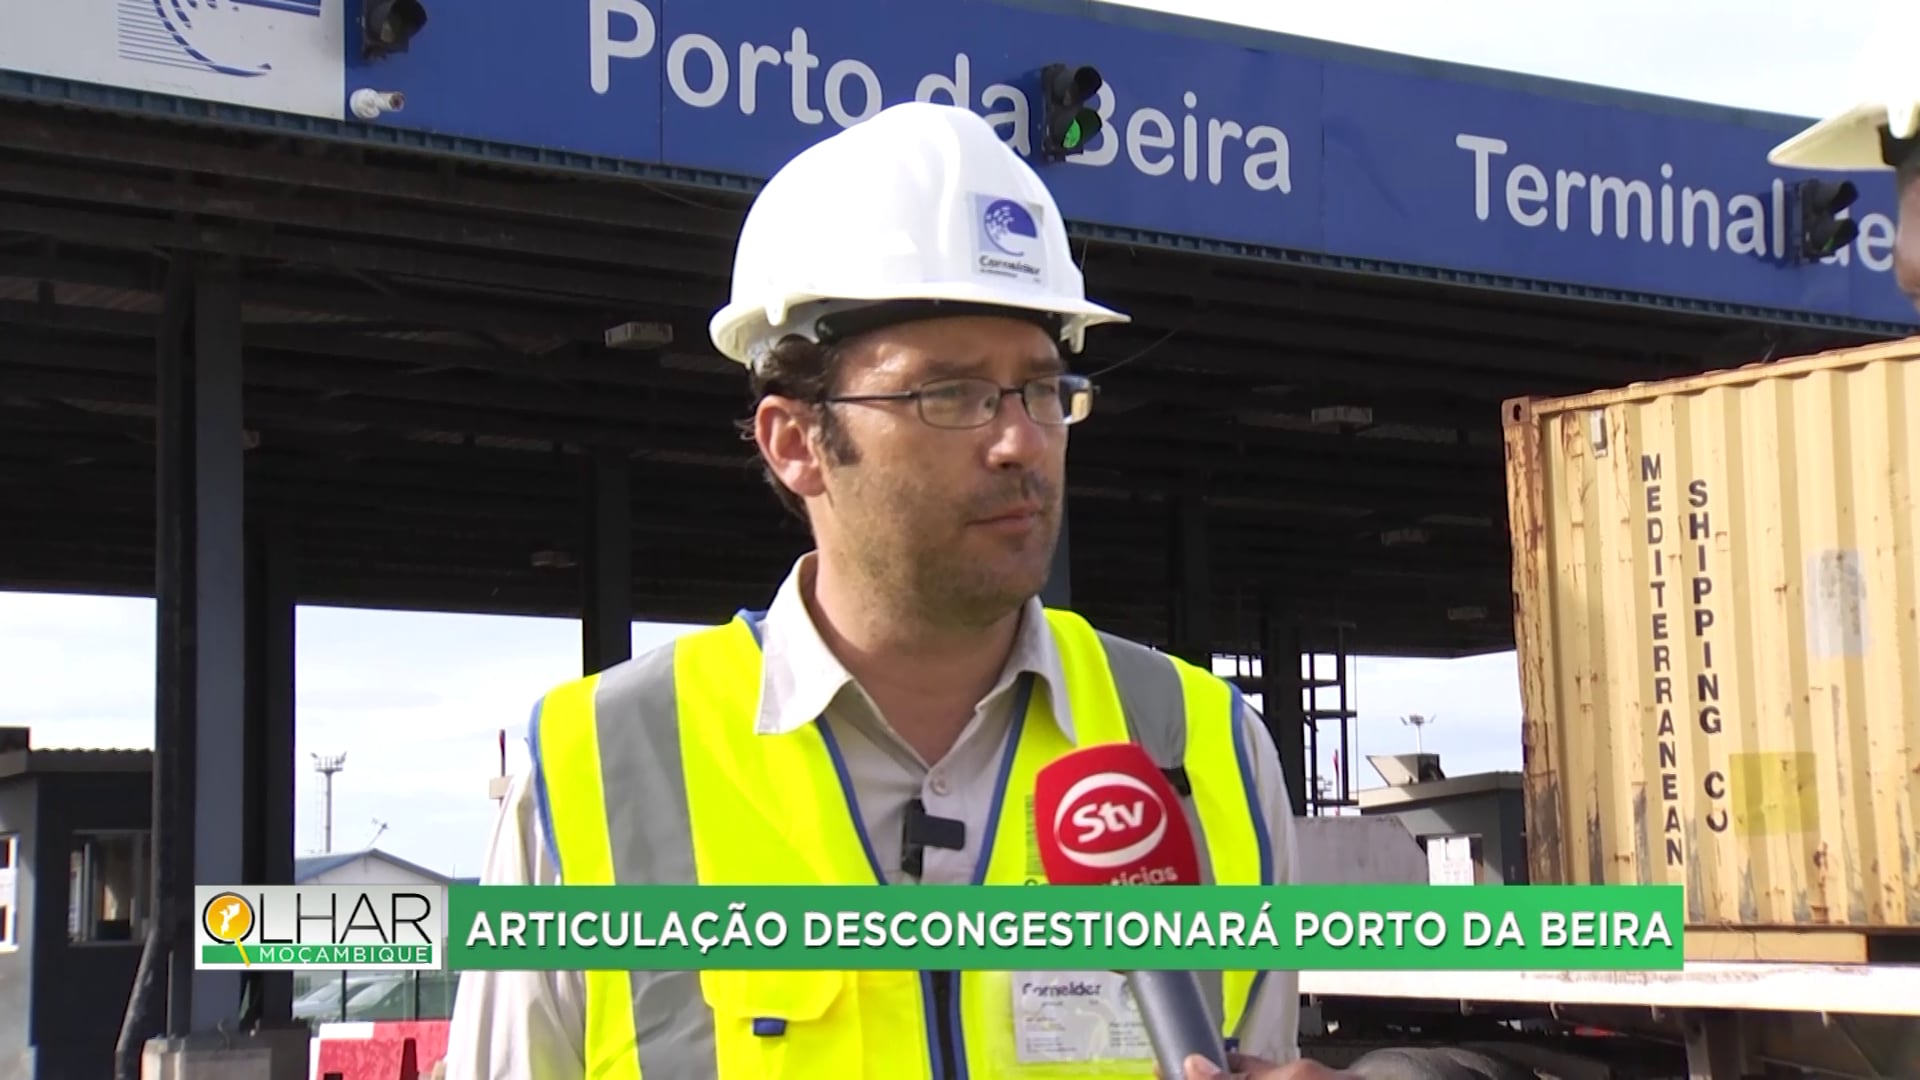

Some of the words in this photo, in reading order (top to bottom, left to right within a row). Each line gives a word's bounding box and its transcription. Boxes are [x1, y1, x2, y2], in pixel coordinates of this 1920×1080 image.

[589, 0, 883, 129] Porto
[1456, 133, 1785, 259] Terminal
[1641, 453, 1683, 866] MEDITERRANEAN
[1688, 479, 1722, 734] SHIPPING
[1072, 800, 1145, 844] Stv
